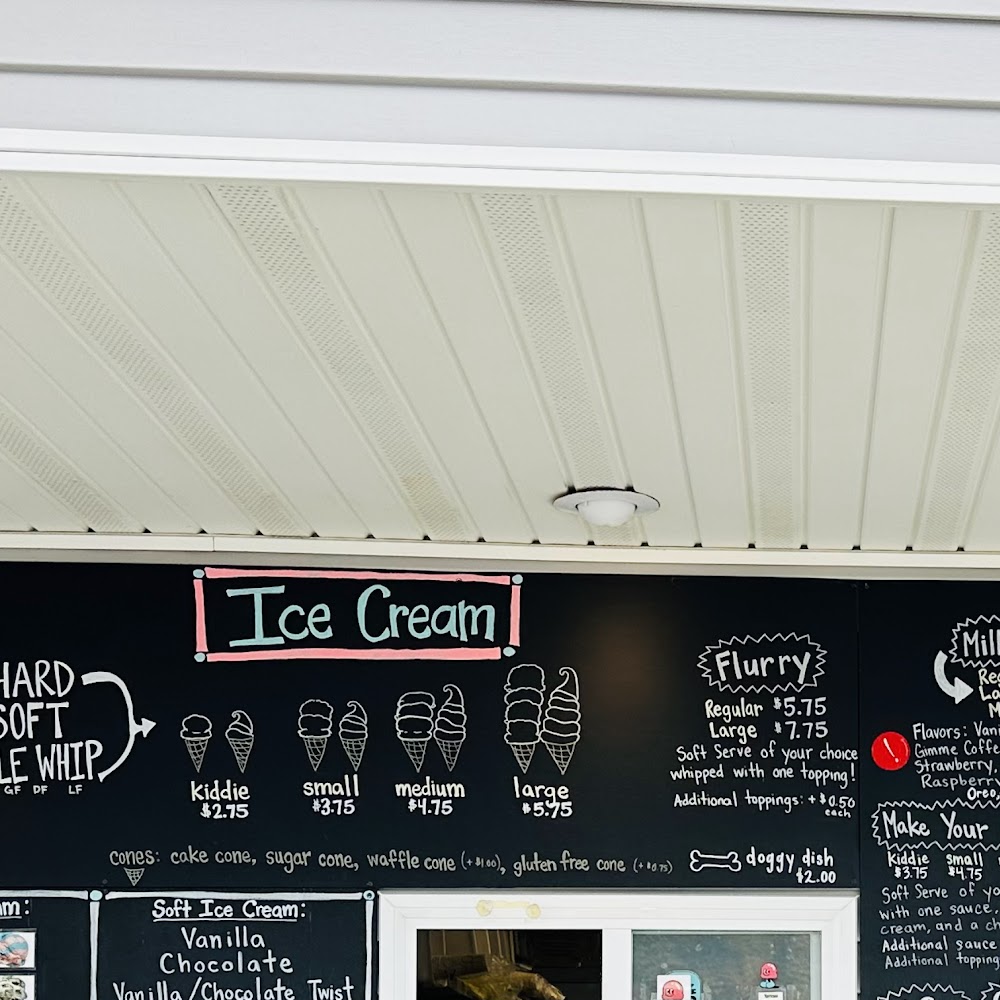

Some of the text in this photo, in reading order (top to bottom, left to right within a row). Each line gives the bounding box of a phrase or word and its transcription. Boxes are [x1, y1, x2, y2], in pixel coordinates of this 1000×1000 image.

[226, 584, 495, 647] Ice Cream
[716, 650, 811, 684] Flurry
[705, 697, 826, 723] Regular $5.75
[709, 721, 828, 744] Large $7.75
[913, 723, 967, 740] Flavors:
[35, 740, 103, 781] WHIP
[915, 743, 958, 758] Gimme
[4, 785, 82, 795] GF DF LF
[191, 780, 250, 801] kiddie
[303, 774, 359, 796] small
[395, 777, 465, 797] medium
[514, 776, 568, 799] large
[200, 803, 249, 819] $2.75
[313, 798, 355, 815] $3.75
[408, 798, 453, 815] $4.75
[522, 799, 572, 818] $5.75
[882, 811, 930, 839] Make
[940, 811, 988, 839] Your
[110, 845, 420, 873] cones: cake cone, sugar cone, waffle
[746, 847, 833, 873] doggy dish
[796, 868, 836, 883] $2.00
[152, 900, 306, 918] Soft Ice Cream:
[181, 926, 265, 949] Vanilla
[160, 950, 293, 974] Chocolate
